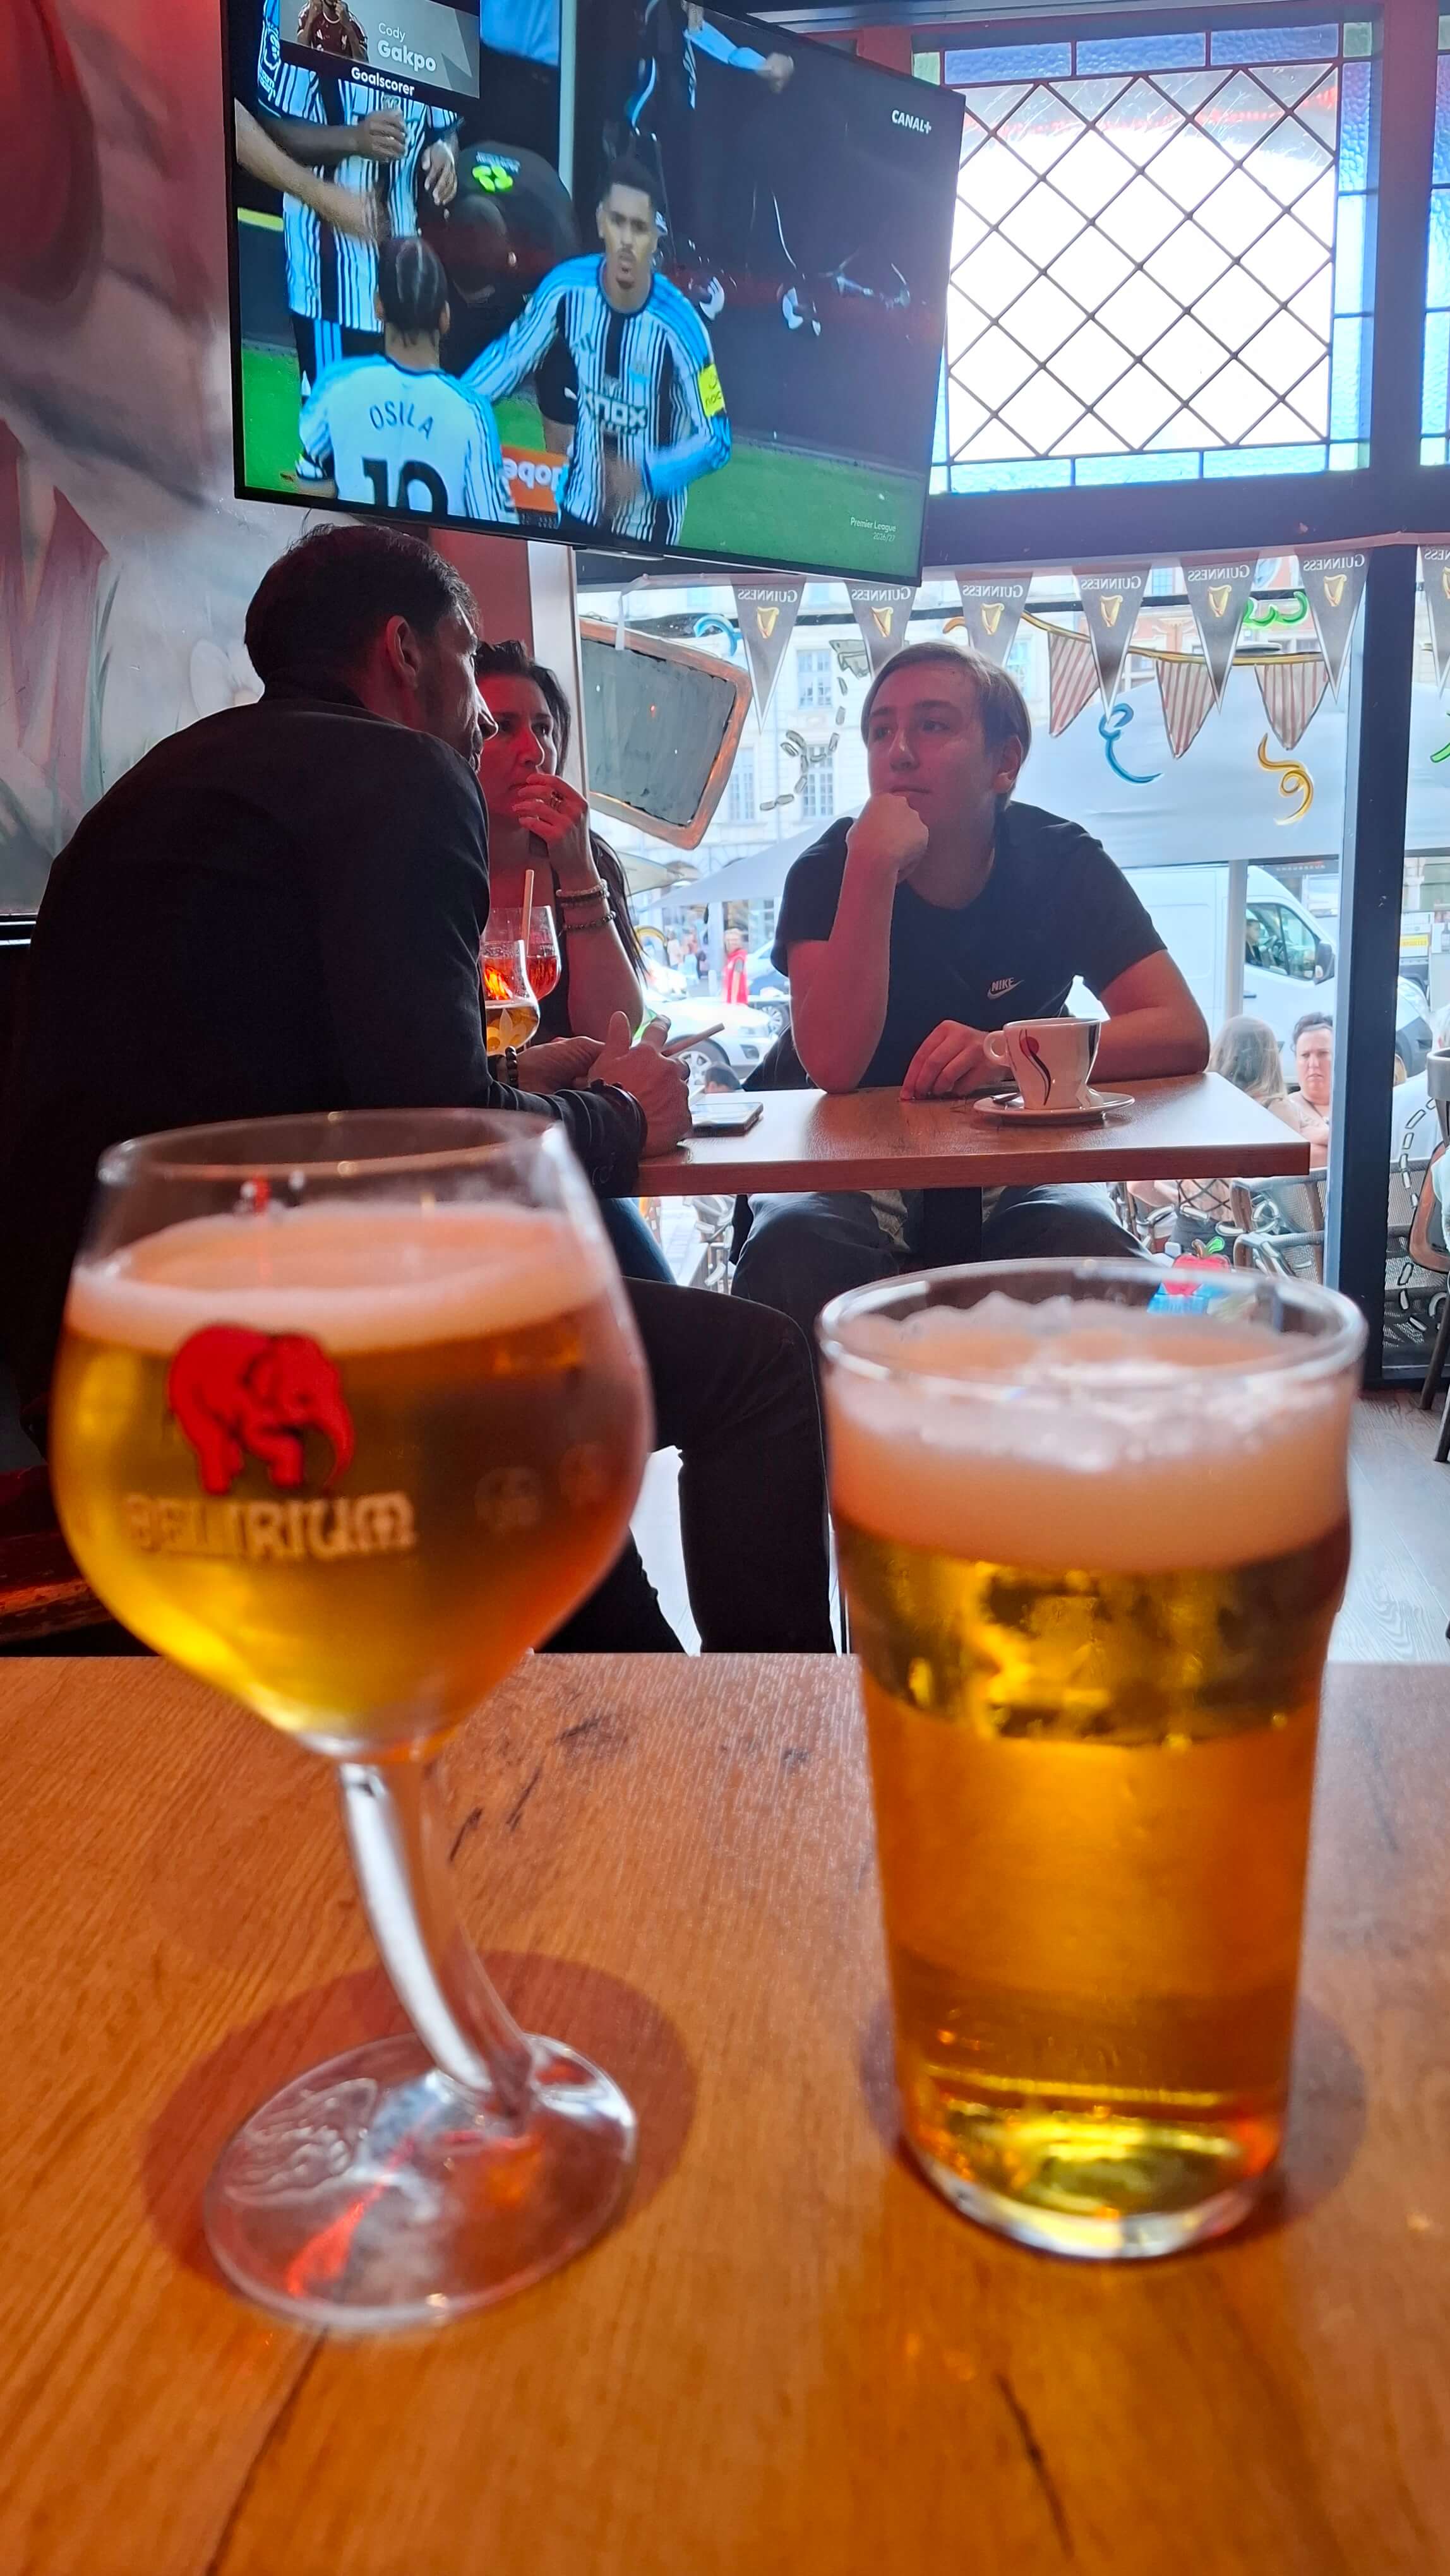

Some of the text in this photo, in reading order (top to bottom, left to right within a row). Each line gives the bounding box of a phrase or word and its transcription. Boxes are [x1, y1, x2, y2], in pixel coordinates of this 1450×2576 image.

[379, 22, 405, 42] Cody
[378, 40, 436, 71] Gakpo
[350, 66, 415, 96] Goalscorer
[892, 110, 932, 134] CANAL+
[850, 516, 896, 533] Premier League
[992, 977, 1014, 992] NIKE
[126, 1491, 417, 1560] DELIRIUM
